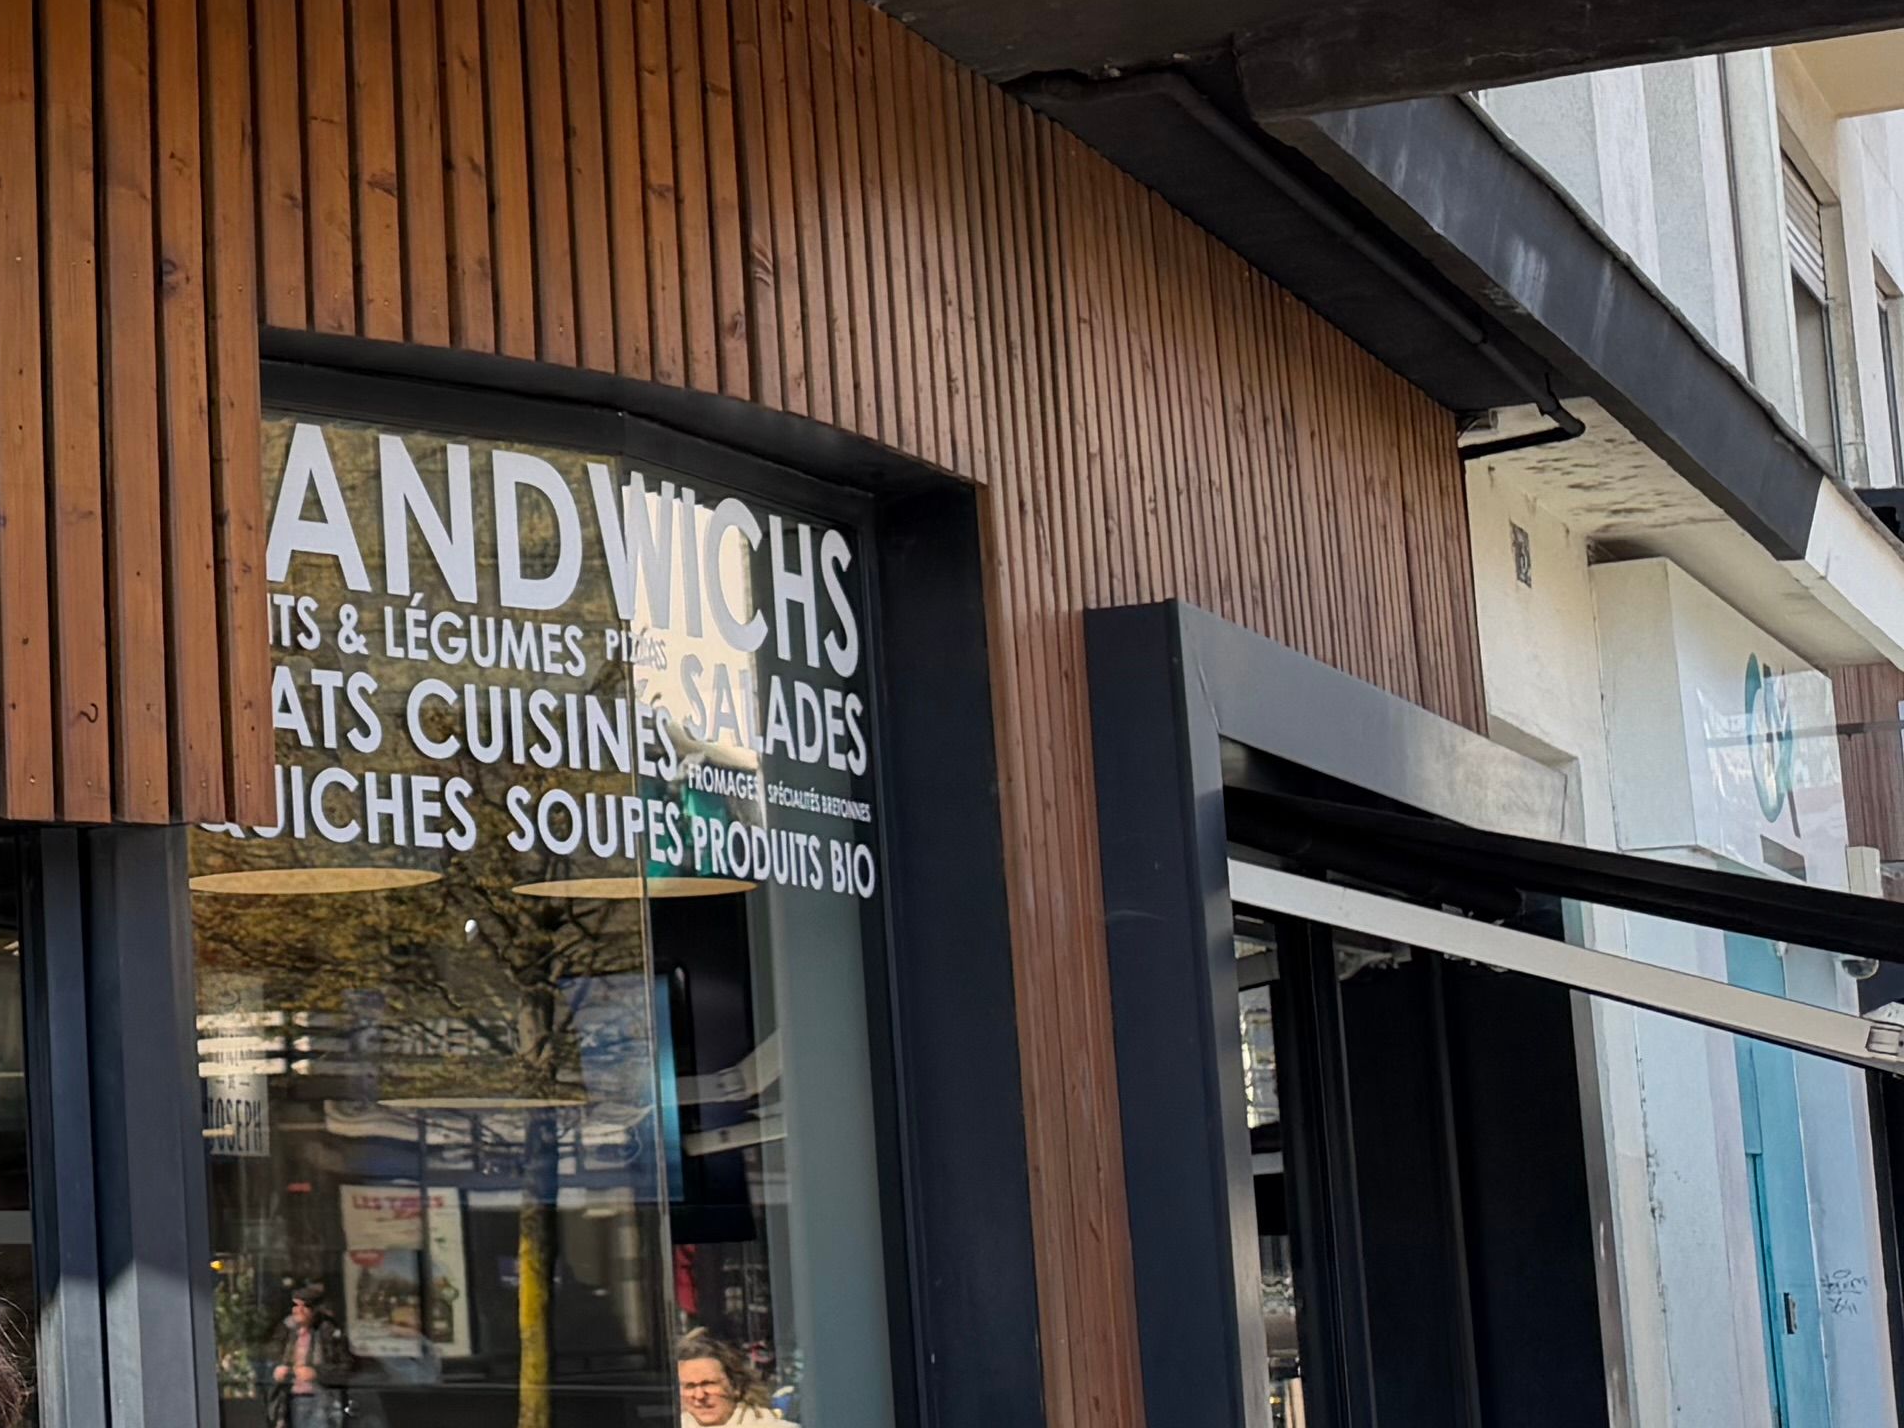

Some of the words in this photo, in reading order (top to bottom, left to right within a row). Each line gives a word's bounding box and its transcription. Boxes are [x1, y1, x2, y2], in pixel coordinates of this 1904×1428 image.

[266, 422, 859, 678] ANDWICHS
[338, 604, 369, 654] &
[384, 592, 587, 677] LÉGUMES
[406, 678, 677, 782] CUISINÉS
[680, 654, 868, 776] SALADES
[200, 764, 478, 852] UICHES
[506, 789, 683, 866] SOUPES
[688, 763, 760, 802] FROMAGES
[767, 780, 821, 813] SPÉCIALITÉS
[821, 794, 872, 823] BRETONNES
[693, 815, 824, 891] PRODUITS
[830, 839, 876, 899] BIO
